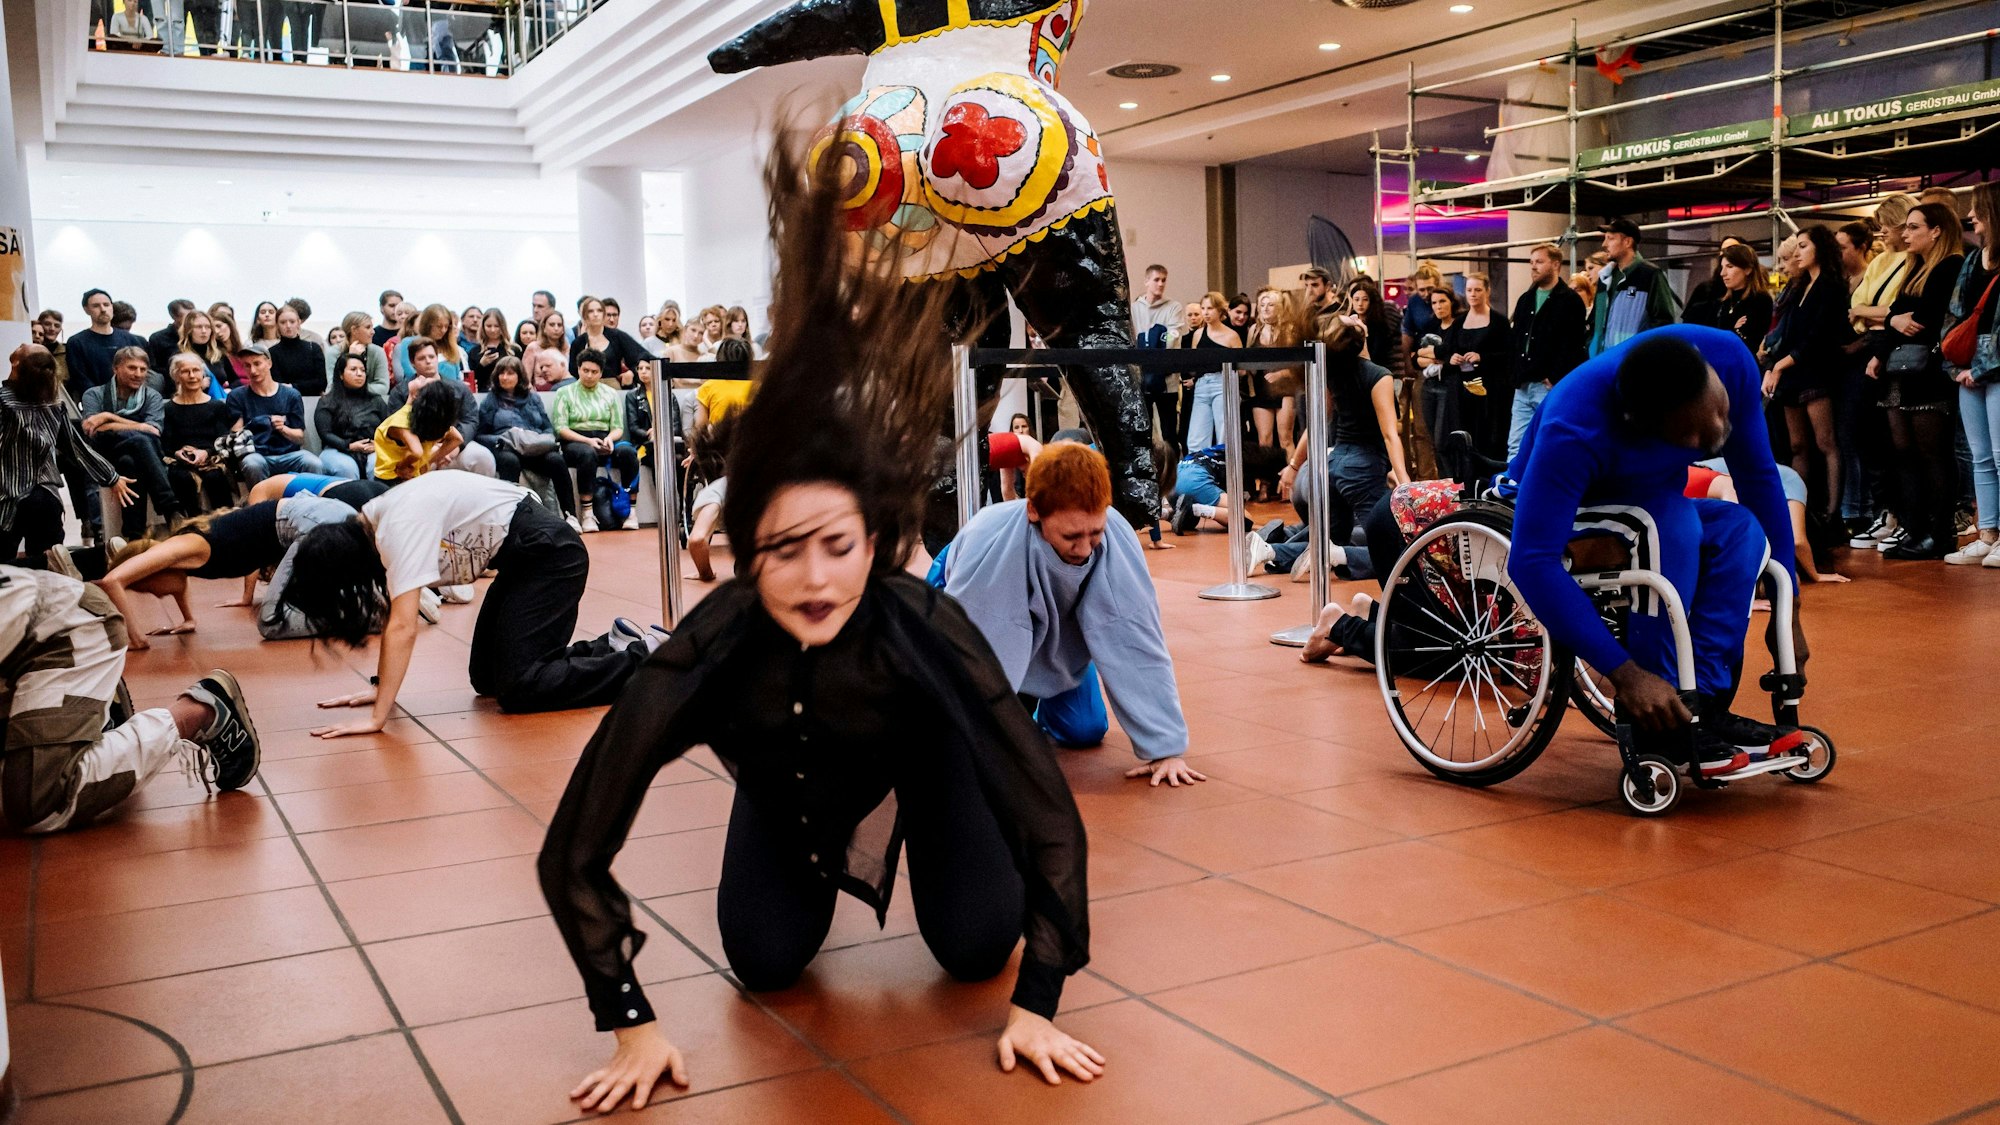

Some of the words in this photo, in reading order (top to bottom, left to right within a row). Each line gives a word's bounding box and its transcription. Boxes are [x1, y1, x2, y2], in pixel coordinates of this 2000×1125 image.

[1812, 111, 1839, 129] ALI
[1843, 100, 1902, 123] TOKUS
[1905, 92, 1970, 113] GERÜSTBAU
[1601, 147, 1622, 162] ALI
[1625, 139, 1671, 158] TOKUS
[1673, 134, 1722, 150] GERÜSTBAU
[1723, 130, 1749, 142] GmbH
